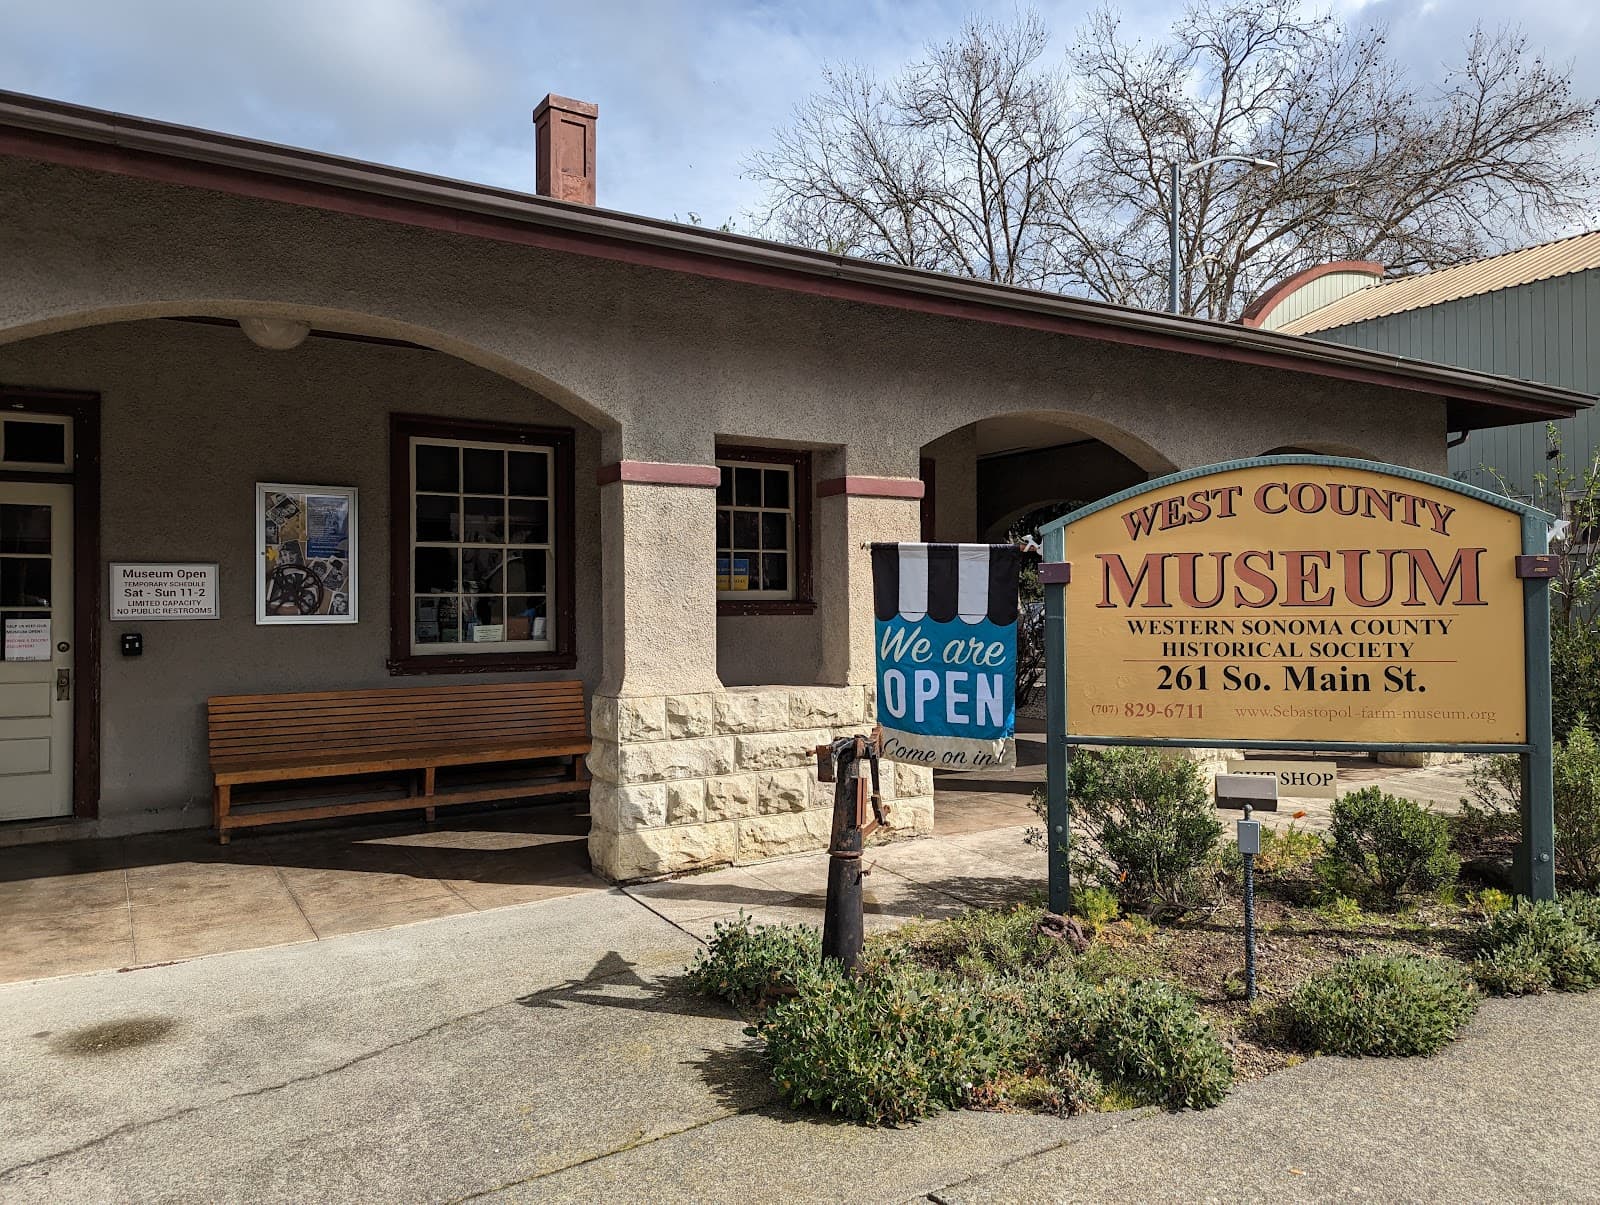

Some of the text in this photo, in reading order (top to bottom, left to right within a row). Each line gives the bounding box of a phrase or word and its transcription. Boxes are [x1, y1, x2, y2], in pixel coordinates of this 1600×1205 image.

[1121, 482, 1456, 541] WEST COUNTY
[122, 569, 207, 580] Museum Open
[1095, 547, 1489, 608] MUSEUM
[124, 588, 143, 597] Sat
[155, 588, 176, 597] Sun
[180, 588, 206, 597] 11-2
[162, 599, 202, 607] CAPACITY
[1127, 619, 1453, 636] WESTERN SONOMA COUNTY
[880, 625, 1007, 667] We are
[1162, 641, 1415, 658] HISTORICAL SOCIETY
[1156, 664, 1426, 693] 261 So. Main St.
[883, 668, 1004, 728] OPEN
[1090, 702, 1204, 719] (707) 829-6711
[883, 738, 937, 761] Come
[942, 751, 968, 764] on
[1280, 771, 1334, 786] SHOP
